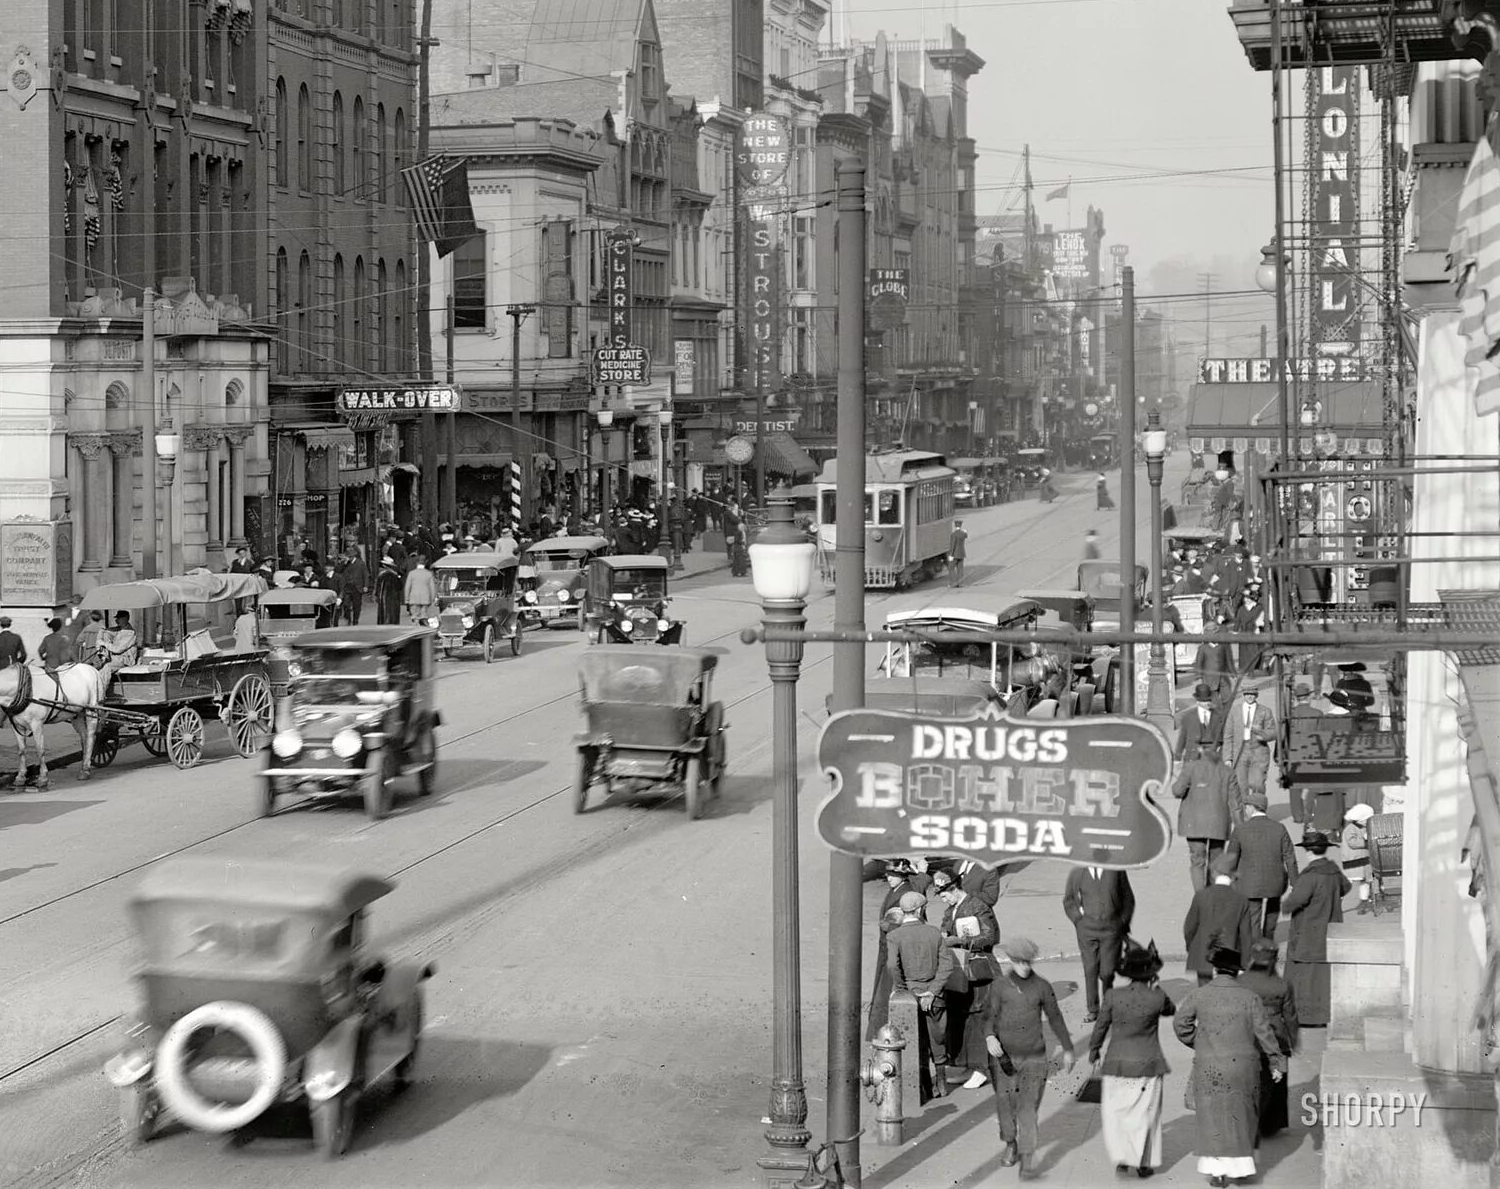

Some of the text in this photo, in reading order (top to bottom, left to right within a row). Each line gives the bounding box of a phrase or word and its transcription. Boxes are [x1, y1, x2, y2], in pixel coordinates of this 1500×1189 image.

[745, 119, 777, 131] THE
[743, 136, 780, 147] NEW
[738, 152, 786, 164] STORE
[752, 169, 772, 180] OF
[876, 269, 904, 279] THE
[871, 281, 908, 300] GLOBE
[598, 349, 643, 360] CUT RATE
[600, 360, 642, 369] MEDICINE
[600, 370, 642, 381] STORE
[345, 390, 452, 409] WALK-OVER
[6, 557, 46, 565] COMPANY
[911, 724, 1069, 763] DRUGS
[909, 815, 1073, 855] SODA
